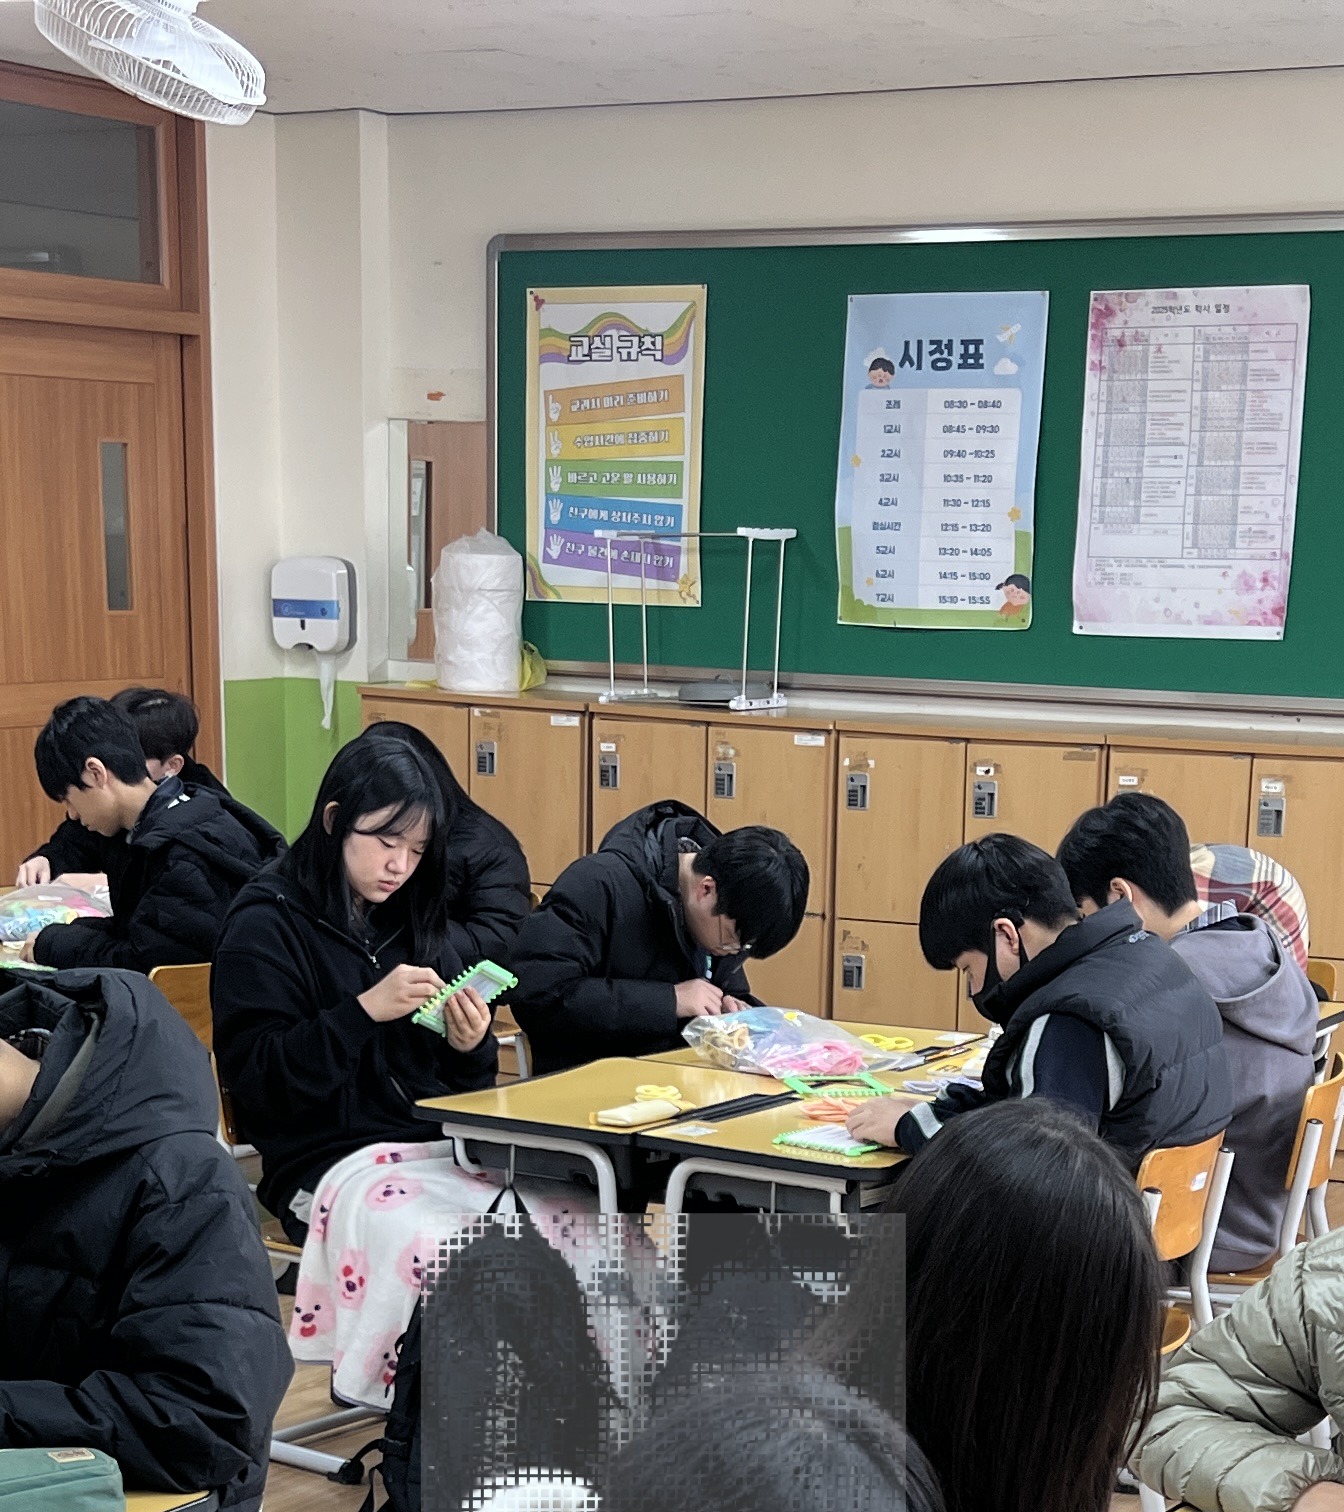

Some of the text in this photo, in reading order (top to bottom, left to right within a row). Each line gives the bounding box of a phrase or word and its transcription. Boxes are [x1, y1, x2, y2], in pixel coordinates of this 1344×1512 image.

[1151, 303, 1230, 315] 2025학년도 학사 일정
[567, 334, 664, 362] 교실 규칙
[898, 338, 985, 371] 시정표
[603, 394, 624, 409] 미리
[627, 389, 669, 406] 준비하기
[944, 400, 968, 409] 08:30
[977, 400, 1002, 409] 08:40
[883, 425, 901, 434] 1교시
[942, 425, 966, 433] 08:45
[975, 425, 999, 434] 09:30
[880, 449, 901, 458] 2교시
[943, 450, 967, 458] 09:40
[567, 471, 598, 484] 바르고
[601, 471, 621, 484] 고운
[636, 472, 677, 486] 사용하기
[879, 473, 899, 483] 3교시
[943, 474, 964, 483] 10:35
[974, 474, 993, 483] 11:20
[878, 498, 898, 507] 4교시
[943, 499, 961, 507] 11:30
[971, 499, 990, 508] 12:15
[568, 506, 609, 522] 친구에게
[654, 514, 675, 528] 않기
[941, 523, 959, 532] 12:15
[969, 523, 992, 532] 13:20
[566, 542, 585, 556] 친구
[653, 554, 674, 568] 않기
[875, 546, 896, 555] 5교시
[938, 547, 960, 556] 13:20
[970, 548, 992, 556] 14:05
[875, 570, 894, 579] 6교시
[939, 571, 958, 580] 14:15
[968, 572, 990, 581] 15:00
[875, 593, 894, 602] 7교시
[938, 596, 958, 604] 15:10
[968, 596, 990, 605] 15:55
